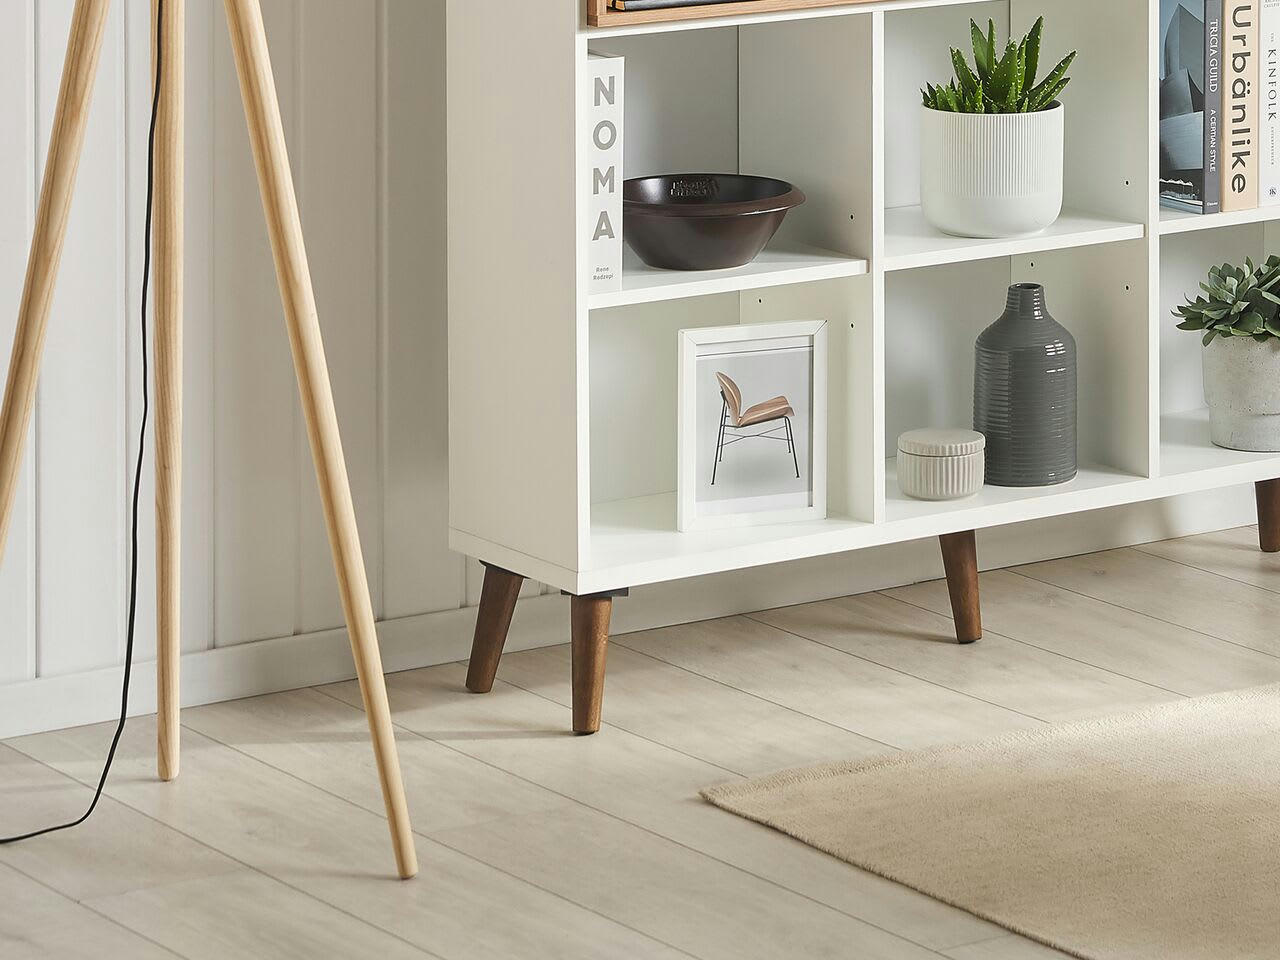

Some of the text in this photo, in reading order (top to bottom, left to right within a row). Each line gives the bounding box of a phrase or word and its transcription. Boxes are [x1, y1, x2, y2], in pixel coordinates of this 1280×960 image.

[1209, 18, 1219, 93] TRICIA GUILD
[1267, 49, 1277, 121] KINFOLK
[1231, 5, 1252, 194] Urbänlike
[592, 75, 617, 241] NOMA
[1209, 149, 1217, 172] STYLE
